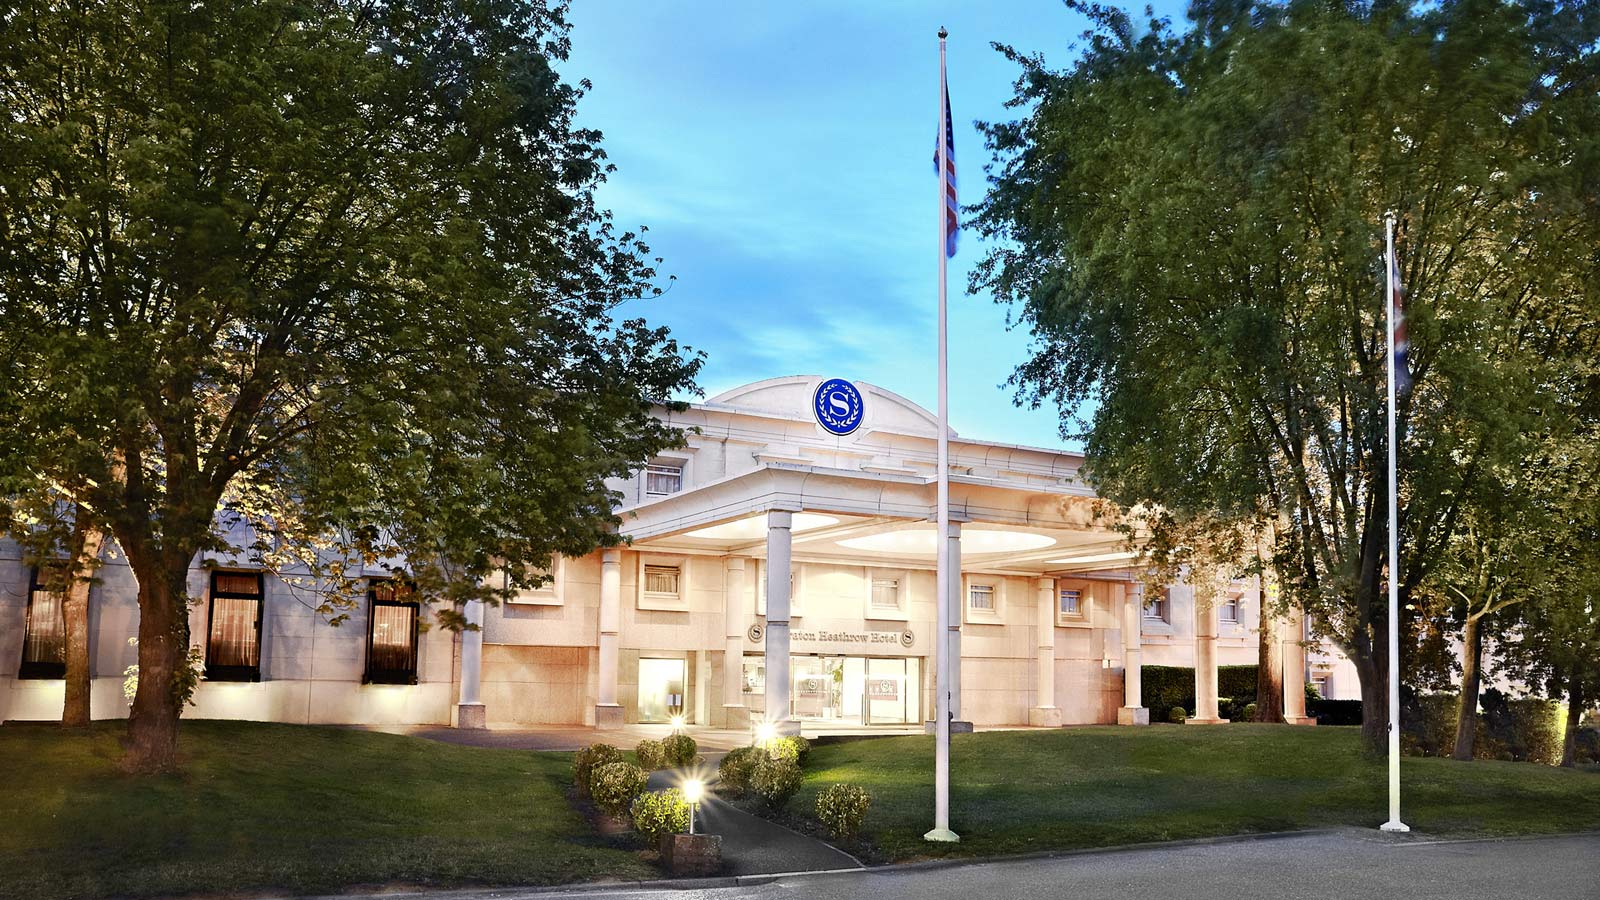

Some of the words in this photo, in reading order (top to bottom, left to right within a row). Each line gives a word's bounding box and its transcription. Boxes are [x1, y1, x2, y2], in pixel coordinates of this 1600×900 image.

[829, 391, 850, 417] S
[819, 631, 869, 642] Heathrow
[871, 632, 898, 643] Hotel
